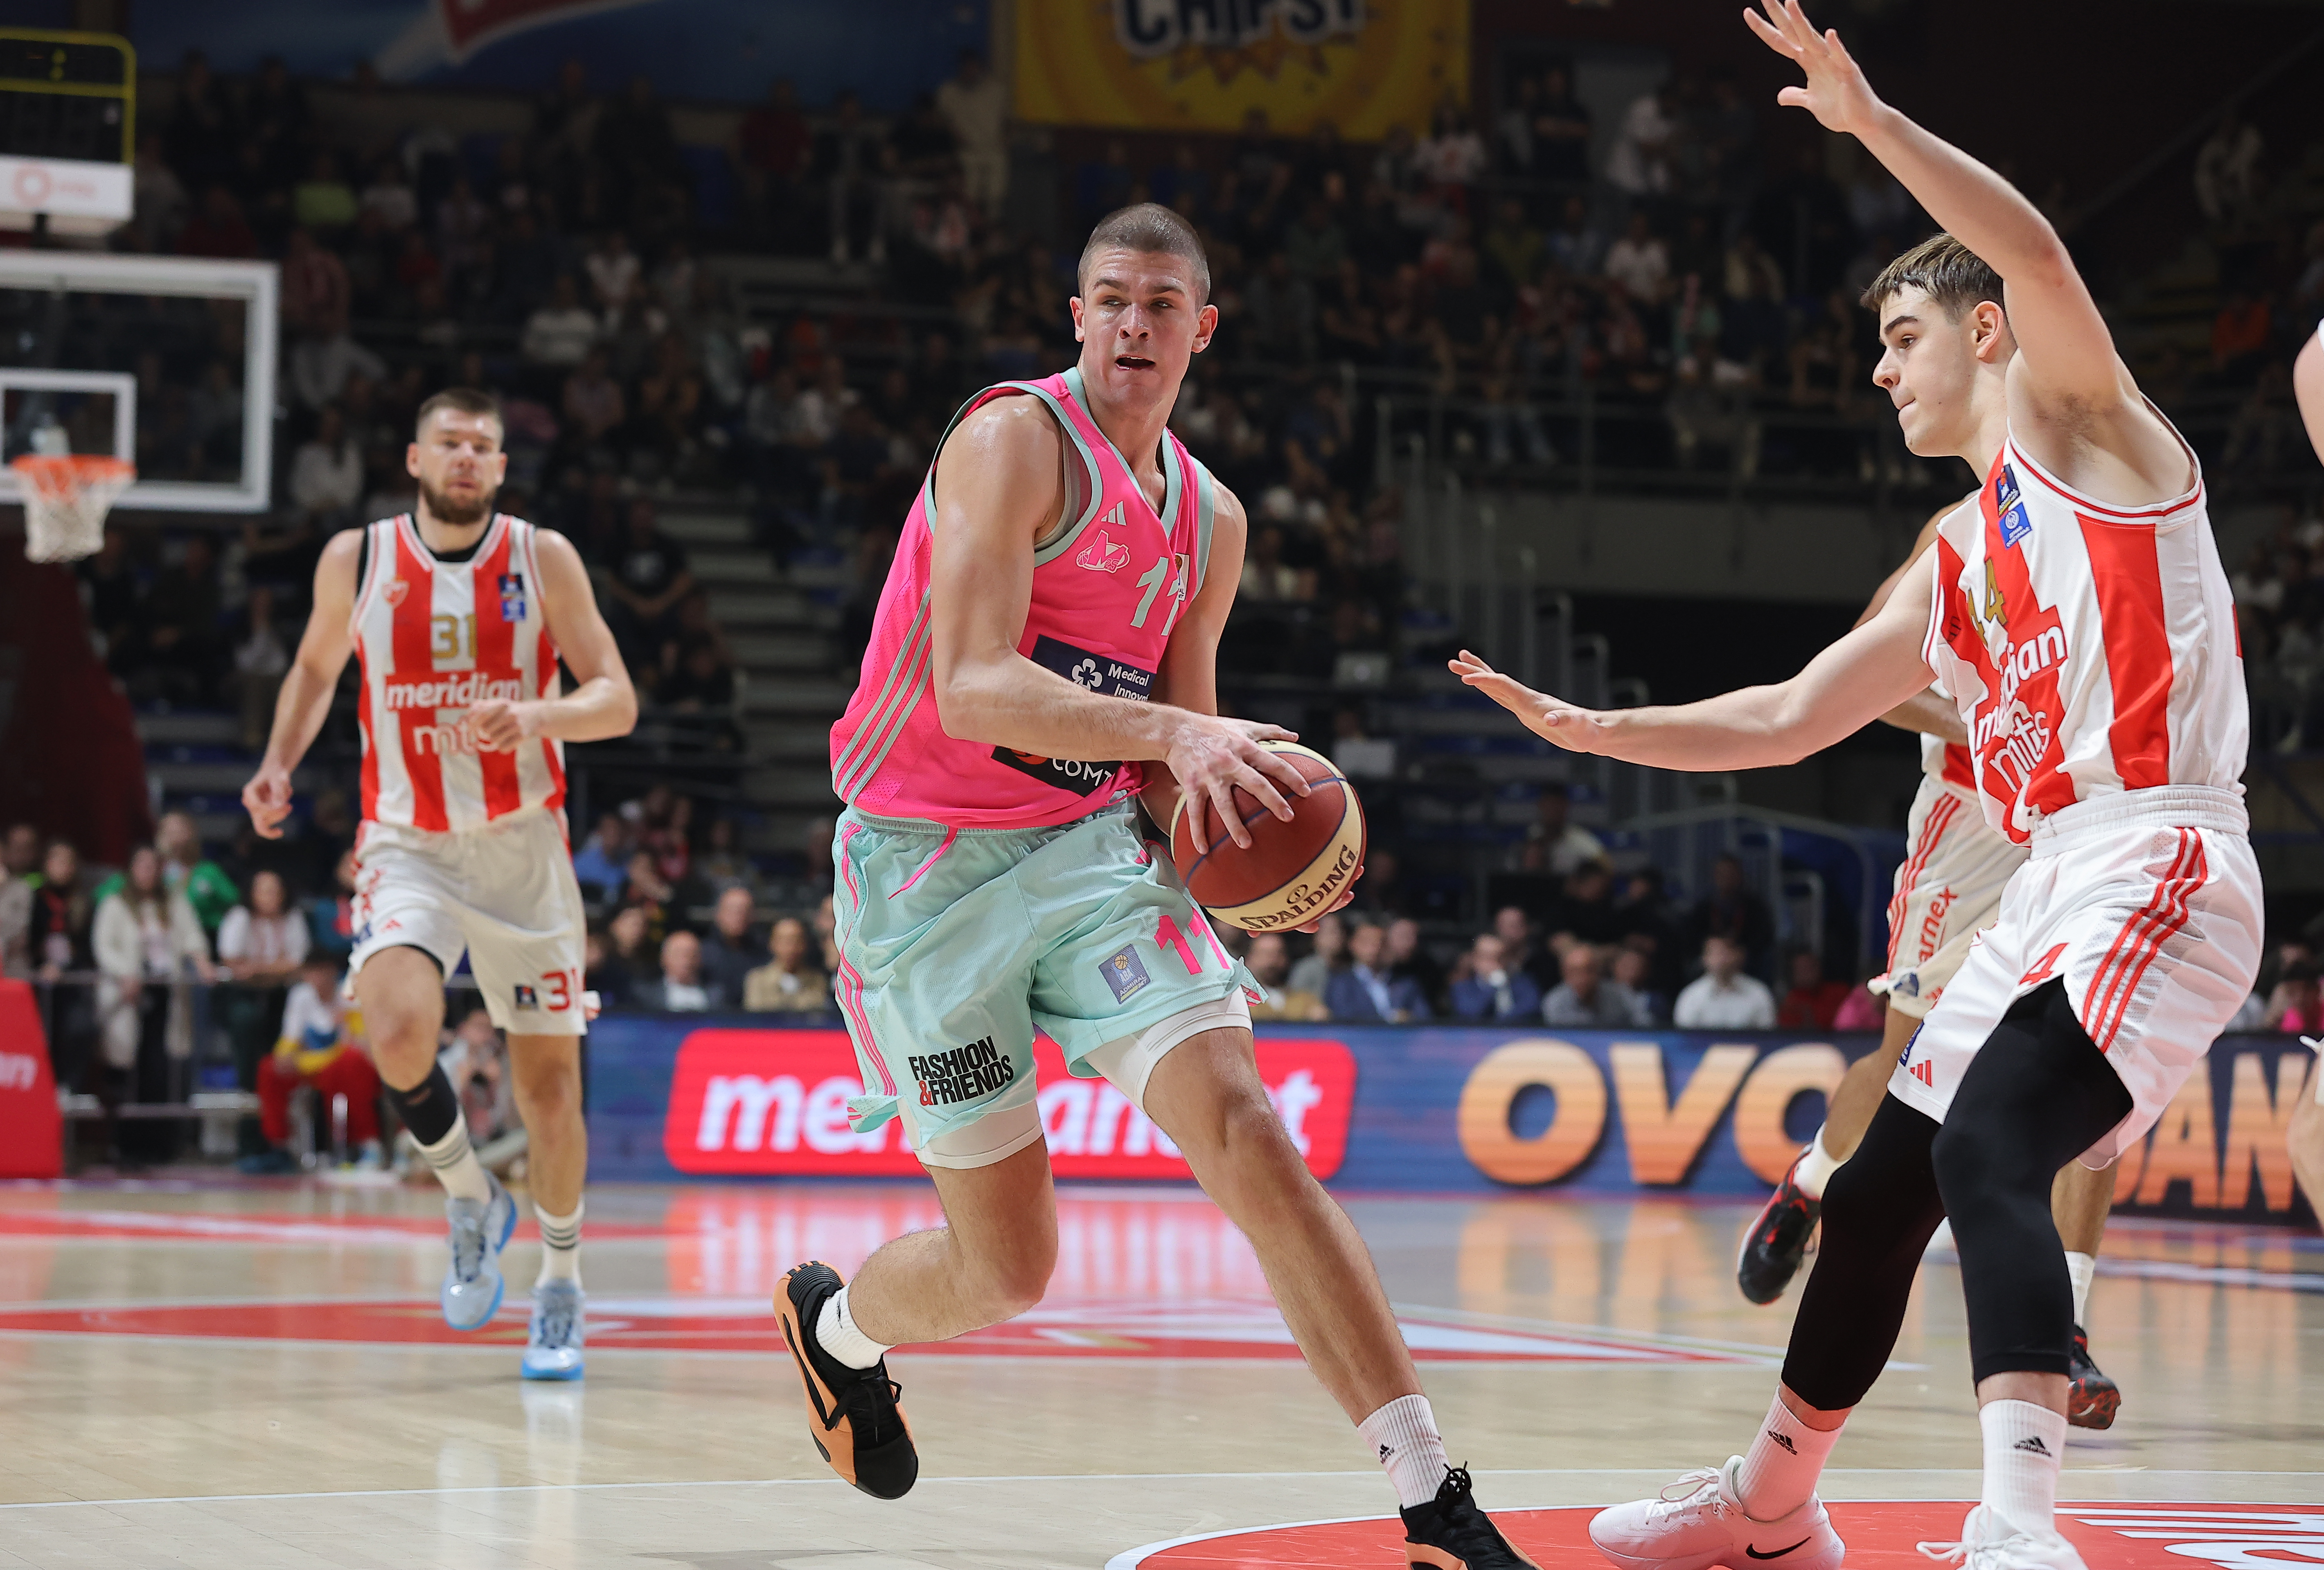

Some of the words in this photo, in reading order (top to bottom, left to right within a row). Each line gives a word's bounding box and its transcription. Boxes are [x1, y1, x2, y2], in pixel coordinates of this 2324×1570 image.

[431, 614, 478, 660] 31
[385, 672, 524, 709] meridian
[1108, 663, 1150, 686] Medical
[1240, 844, 1357, 929] SPALDING
[1153, 907, 1231, 975] 11
[1119, 968, 1134, 984] ABA
[1120, 974, 1146, 997] ADMIRAL
[908, 1035, 999, 1081] FASHION
[919, 1054, 1014, 1106] &FRIENDS
